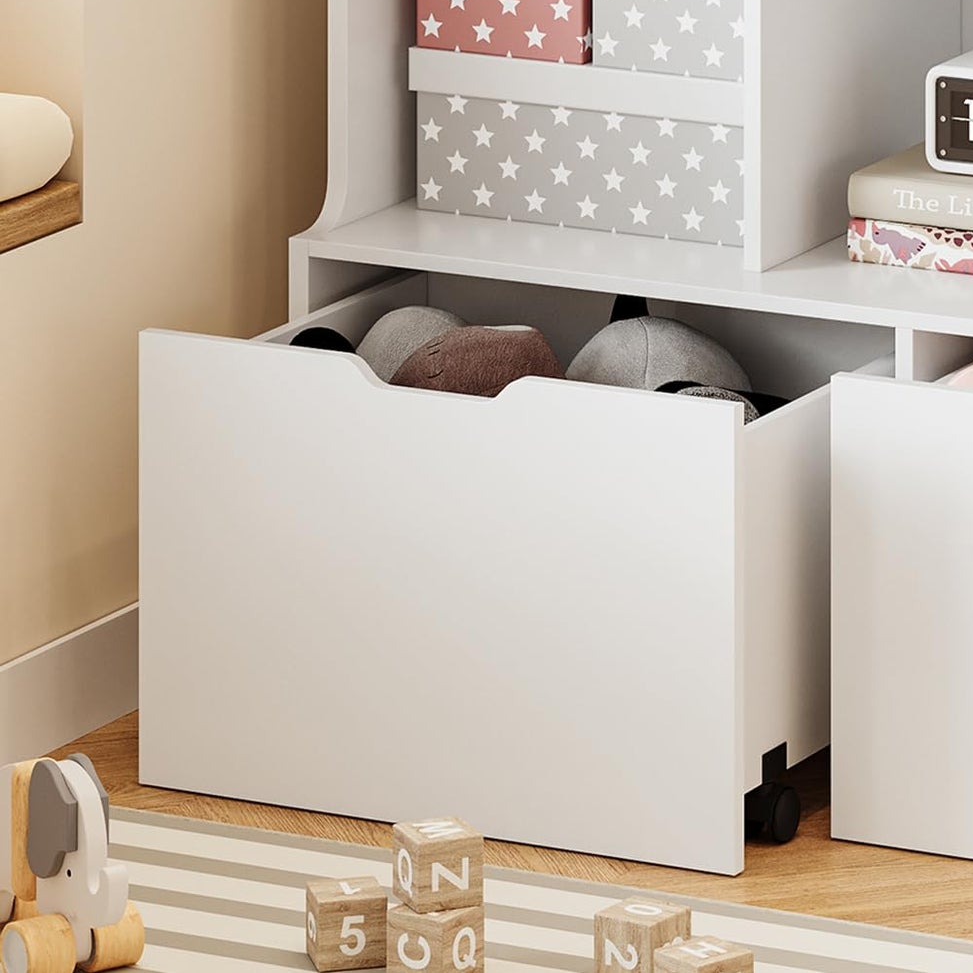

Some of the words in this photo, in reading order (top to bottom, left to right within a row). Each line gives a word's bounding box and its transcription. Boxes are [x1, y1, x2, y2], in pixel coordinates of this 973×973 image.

[893, 189, 940, 213] The
[397, 848, 413, 898] Q
[339, 915, 366, 956] 5
[452, 926, 477, 970] Q
[604, 938, 638, 970] 2
